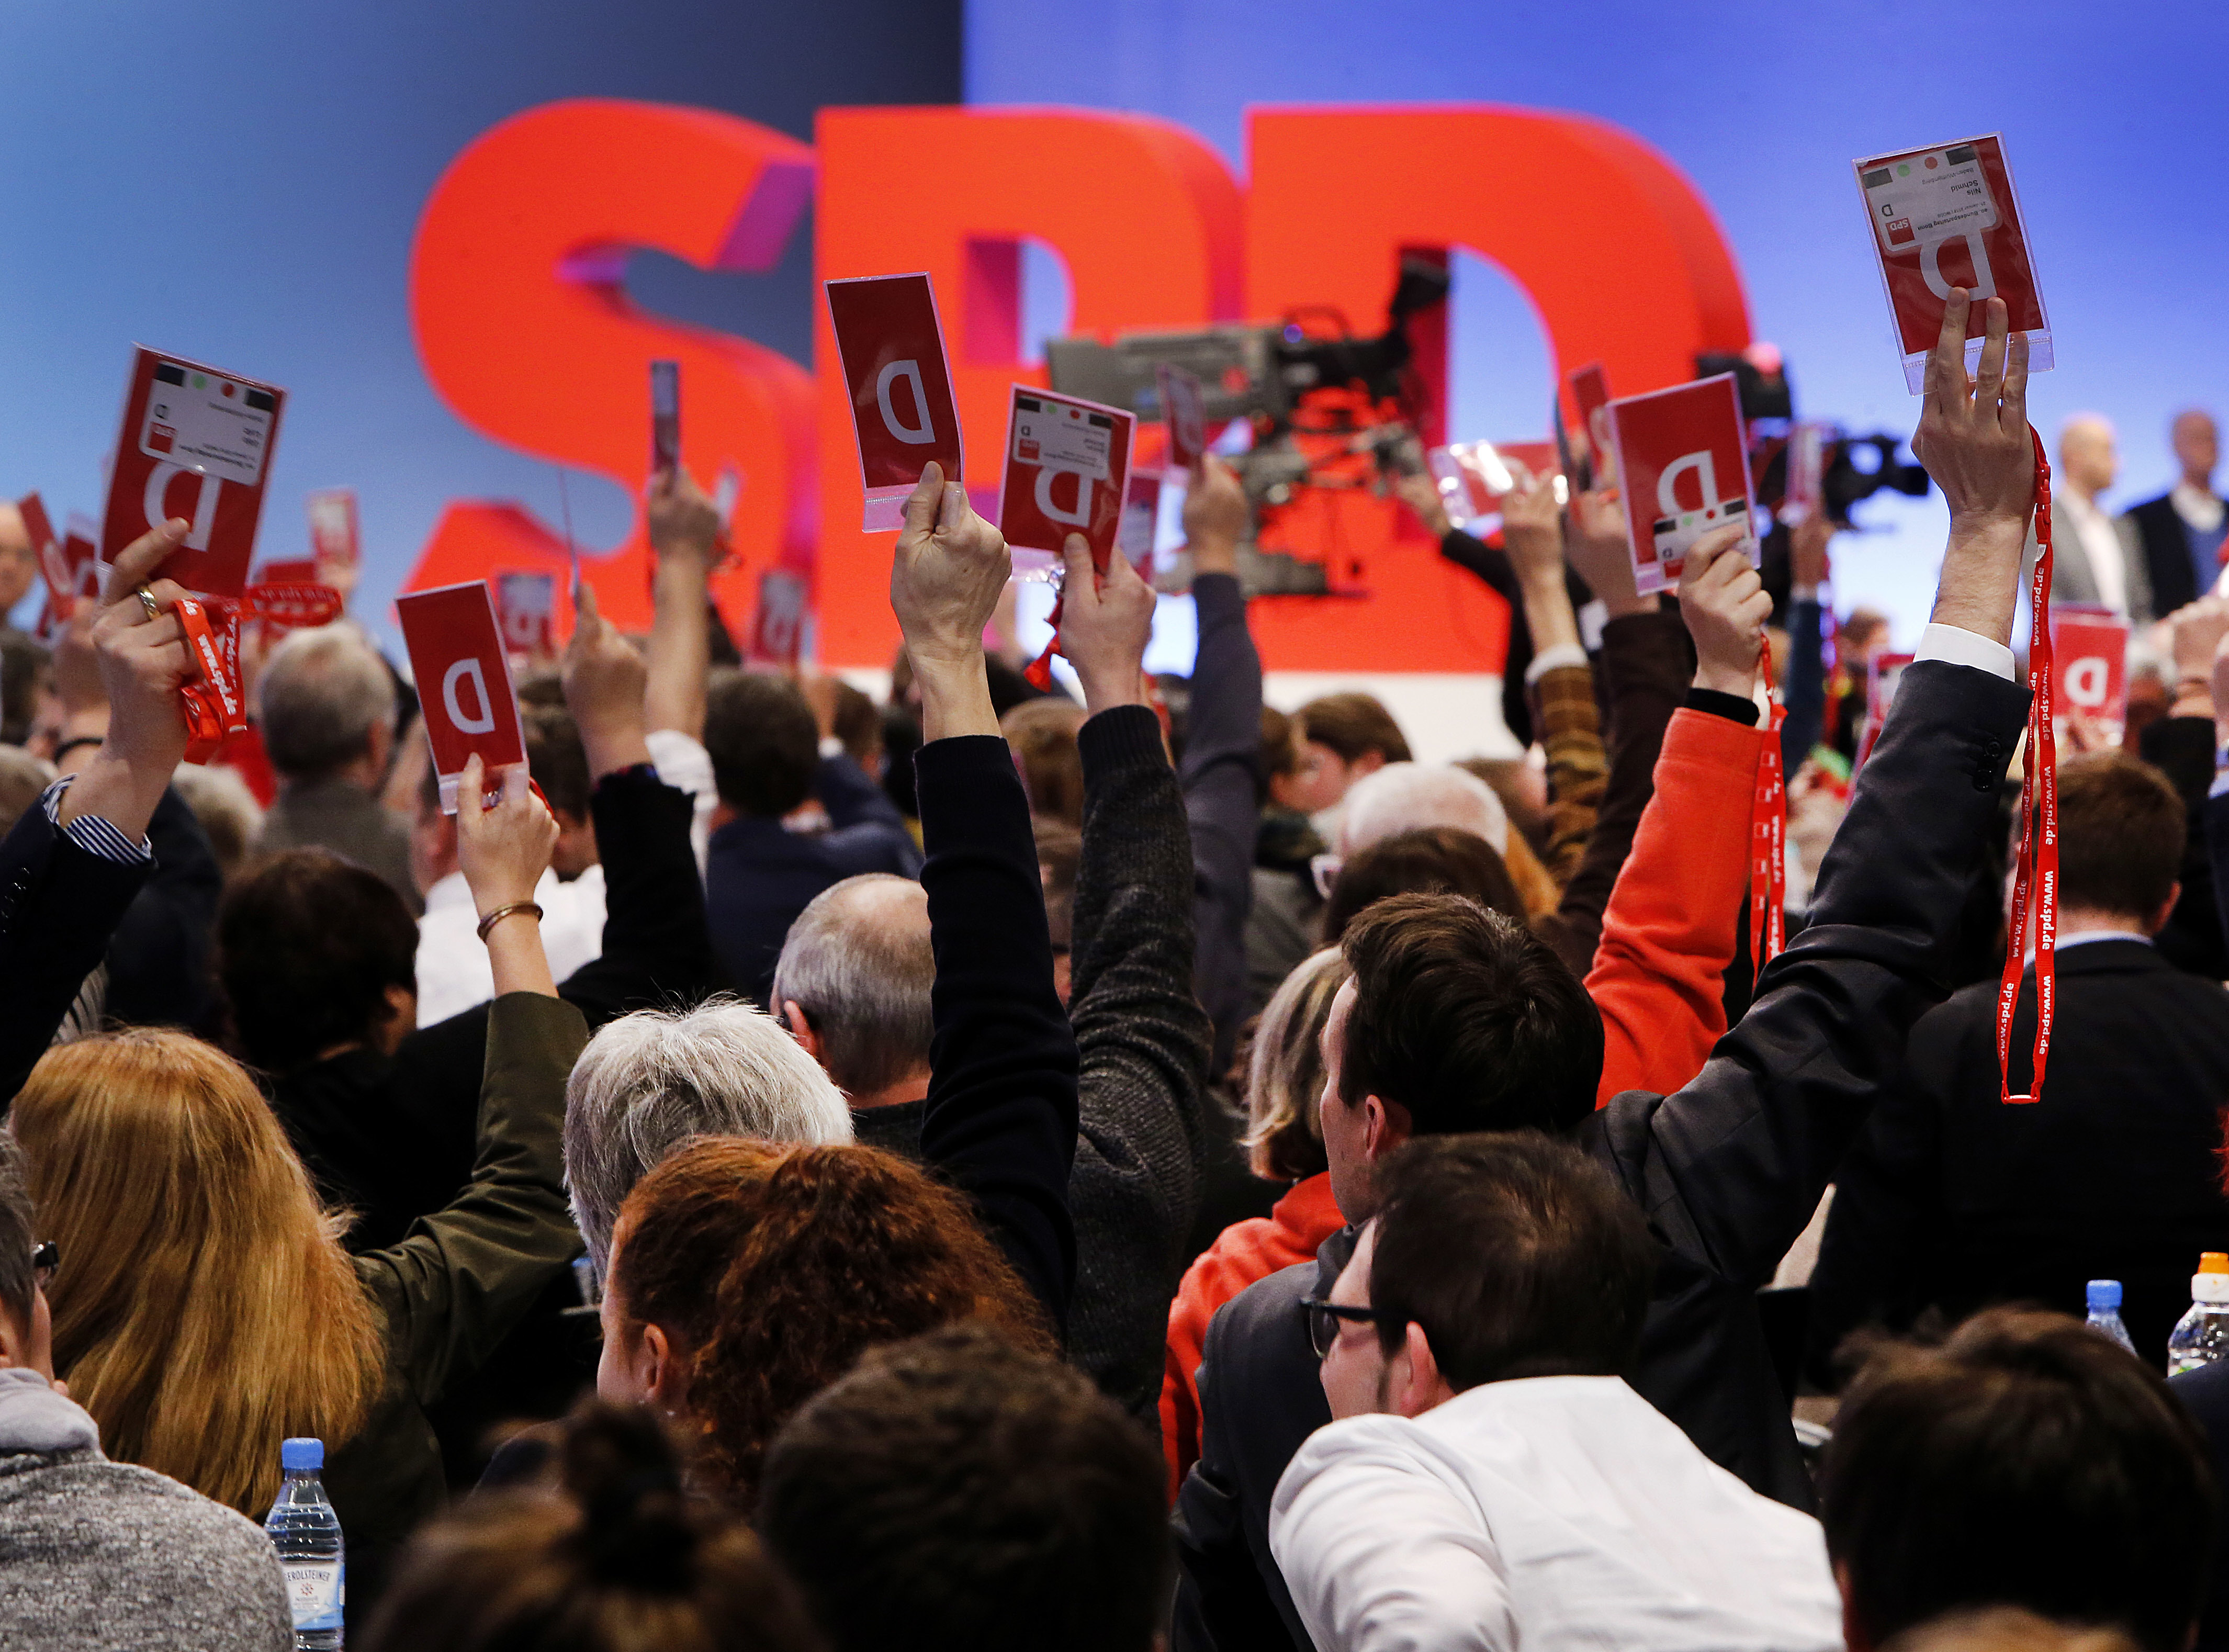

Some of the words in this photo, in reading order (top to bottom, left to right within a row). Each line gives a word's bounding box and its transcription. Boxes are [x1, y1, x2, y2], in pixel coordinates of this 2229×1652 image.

[1881, 204, 1894, 217] D
[1889, 219, 1909, 231] SPD
[1951, 180, 1978, 193] Schmid
[1967, 187, 1982, 196] Nils
[1920, 226, 1998, 302] D
[406, 96, 1752, 672] SPD
[876, 359, 936, 445] D
[143, 458, 224, 552] D
[1034, 464, 1094, 529] D
[1657, 449, 1719, 516] D
[2034, 567, 2044, 646] www.spd.de
[197, 633, 238, 716] www.spd.de
[443, 657, 496, 735] D
[2064, 656, 2108, 706] D
[2044, 766, 2056, 845] www.spd.de
[2040, 871, 2055, 950] www.spd.de
[2000, 983, 2014, 1060] www.spd.de
[2039, 975, 2051, 1054] www.spd.de
